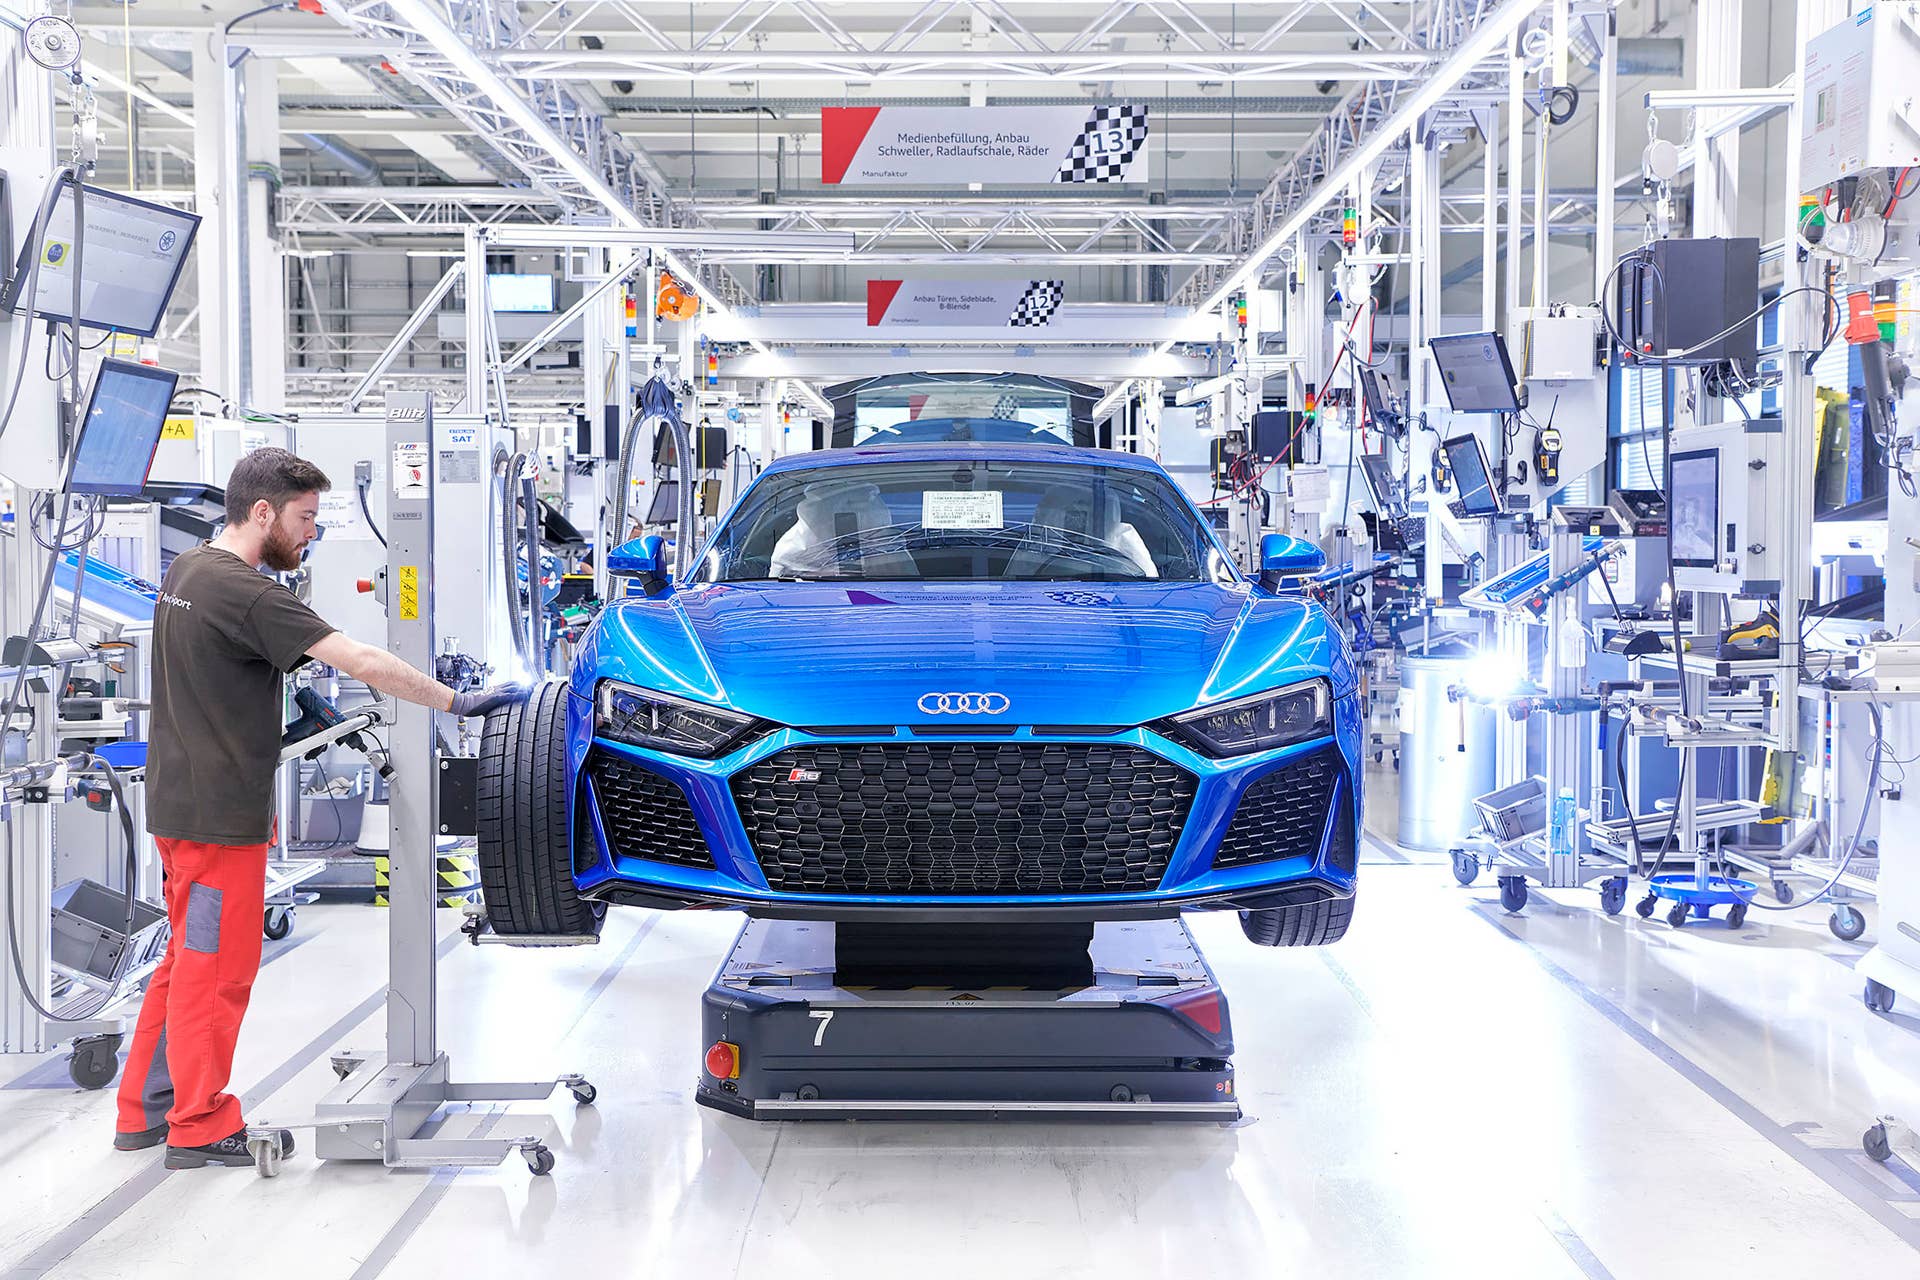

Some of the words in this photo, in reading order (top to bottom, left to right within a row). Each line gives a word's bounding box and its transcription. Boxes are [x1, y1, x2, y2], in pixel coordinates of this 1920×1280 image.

[897, 133, 992, 145] Medienbefüllung,
[995, 133, 1030, 143] Anbau
[1092, 131, 1124, 154] 13
[878, 145, 933, 157] Schweller,
[936, 145, 1015, 157] Radlaufschale,
[1017, 145, 1050, 156] Räder
[862, 170, 908, 178] Manufaktur
[913, 295, 936, 303] Anbau
[937, 294, 960, 304] Türen,
[960, 295, 997, 304] Sideblade,
[1029, 296, 1050, 310] 12
[387, 407, 427, 420] Blitz
[452, 435, 472, 443] SAT
[808, 1010, 834, 1046] 7
